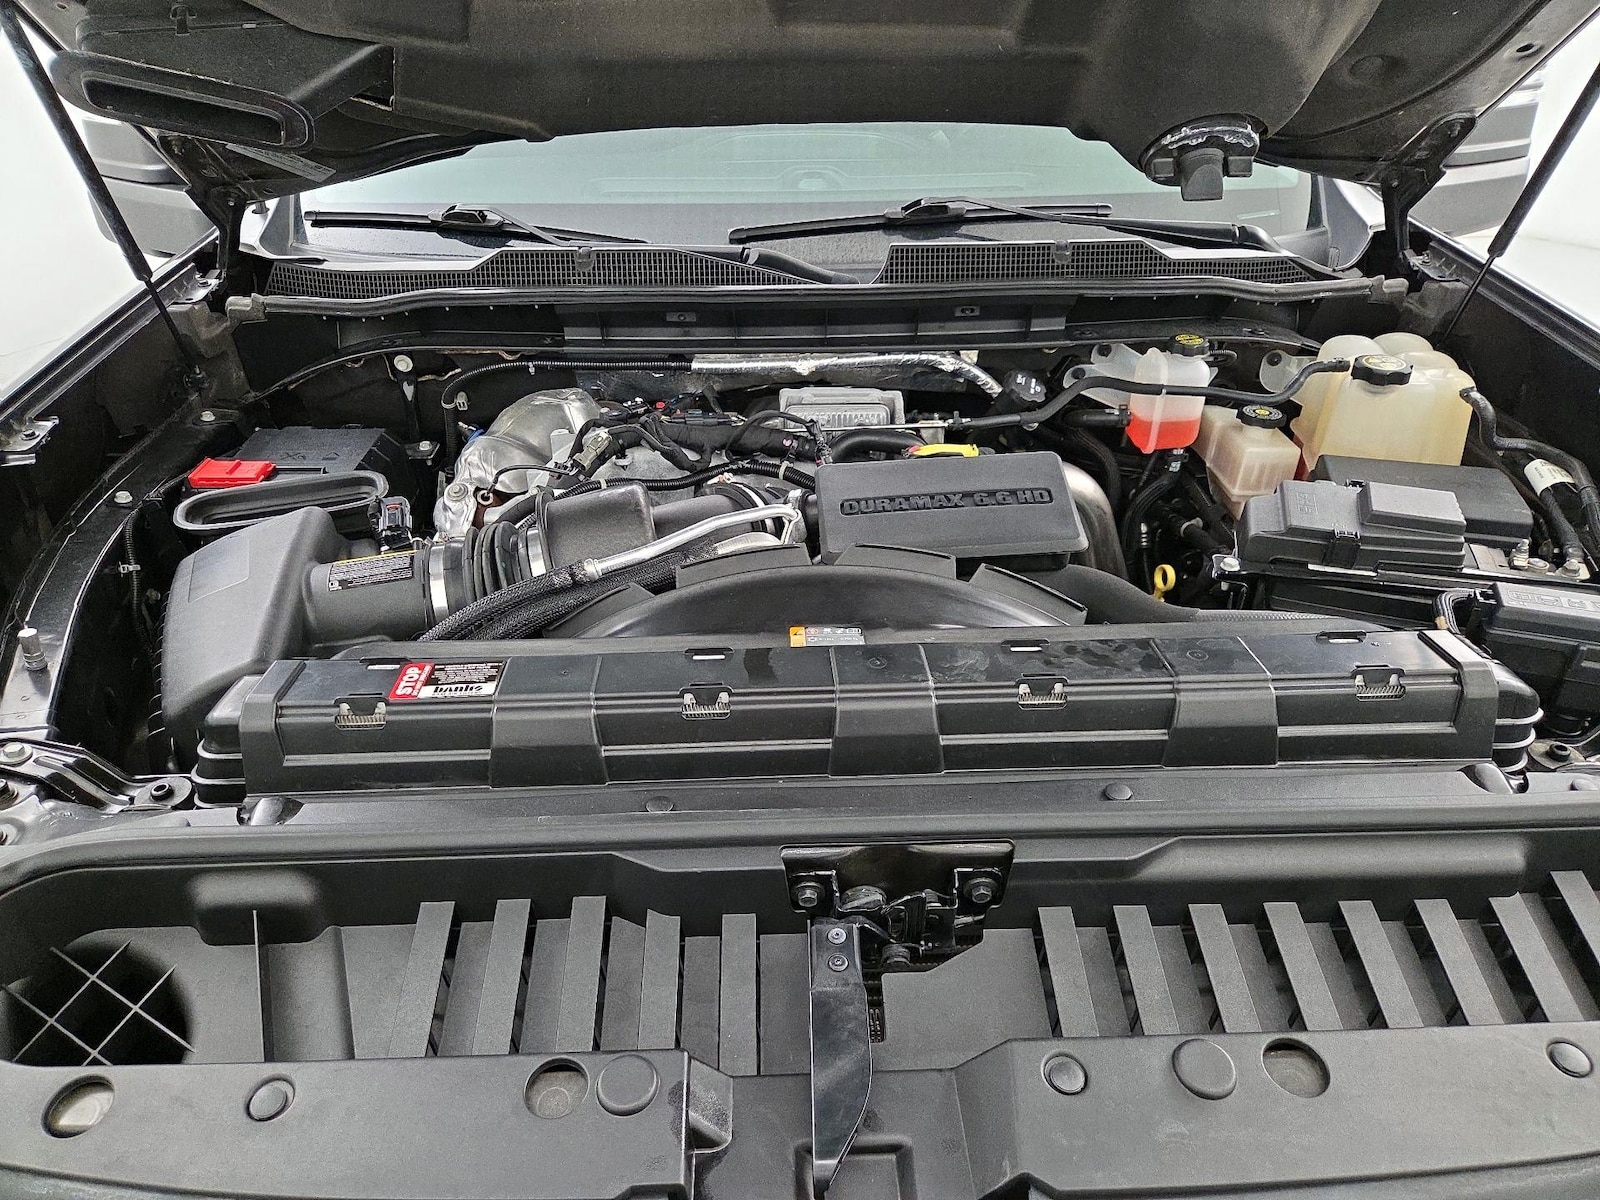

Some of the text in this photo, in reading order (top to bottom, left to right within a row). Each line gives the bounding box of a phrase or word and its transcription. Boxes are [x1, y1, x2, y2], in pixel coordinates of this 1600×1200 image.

[843, 489, 1051, 514] DURAMAX 6.6 HD
[395, 666, 422, 696] STOP
